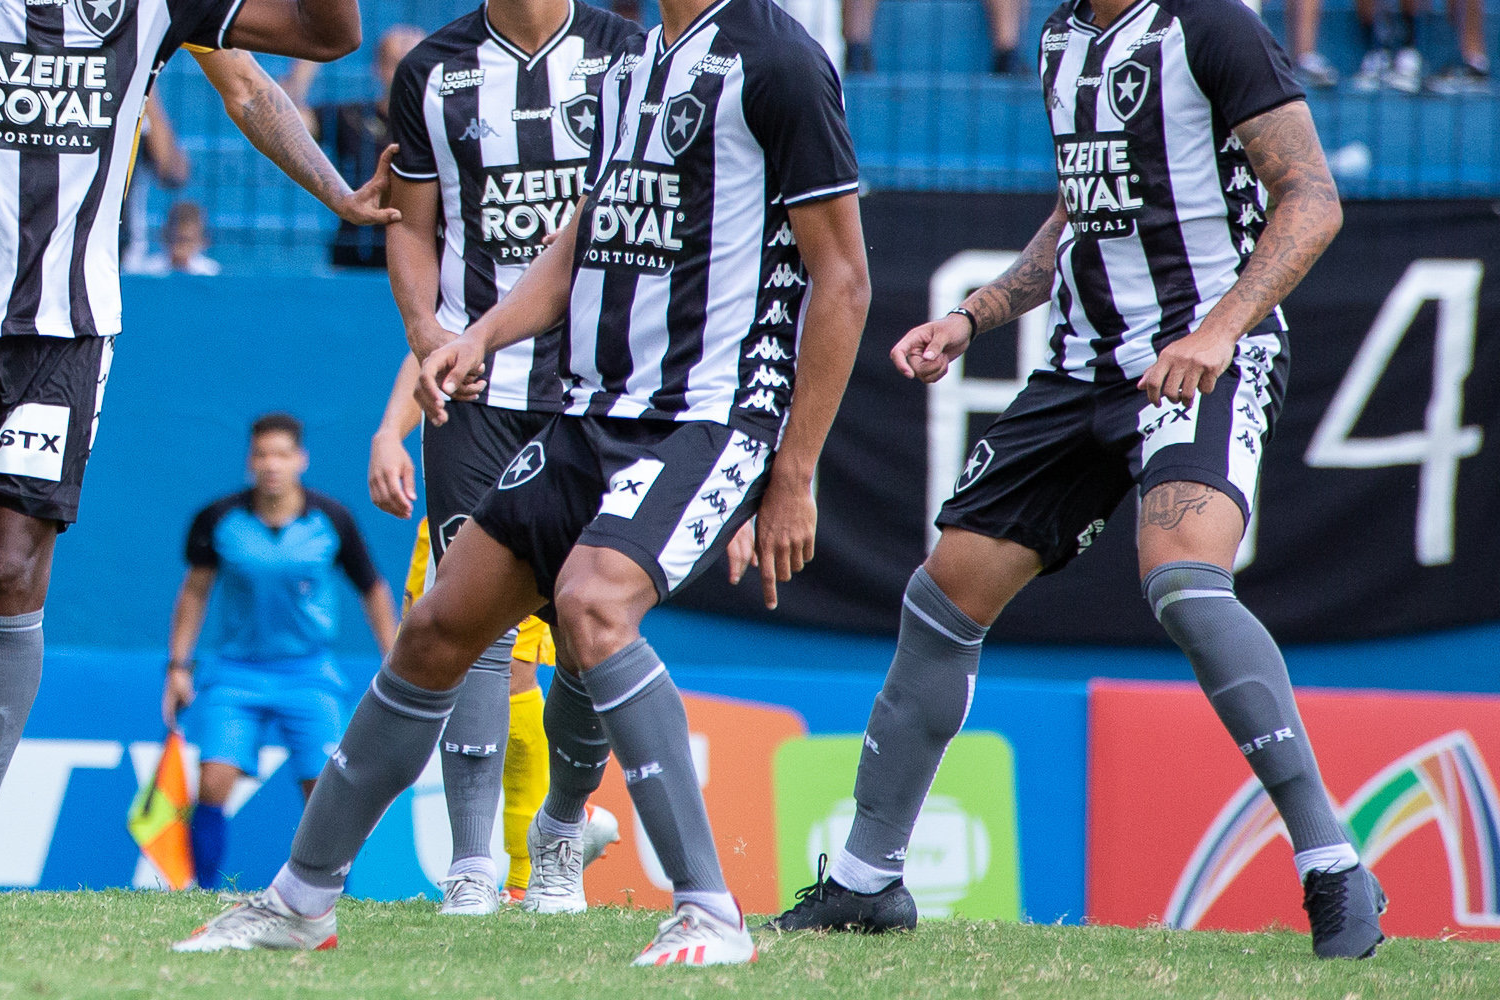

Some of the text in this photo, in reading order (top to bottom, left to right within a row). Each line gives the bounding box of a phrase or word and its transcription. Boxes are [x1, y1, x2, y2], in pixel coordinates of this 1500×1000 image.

[1060, 174, 1144, 214] OYAL
[501, 244, 553, 258] PORT
[588, 249, 666, 269] ORTUGAL
[1143, 407, 1193, 441] STX
[1304, 258, 1484, 566] 4
[0, 429, 61, 454] STX
[445, 742, 498, 755] BFR
[1240, 727, 1296, 756] BFR
